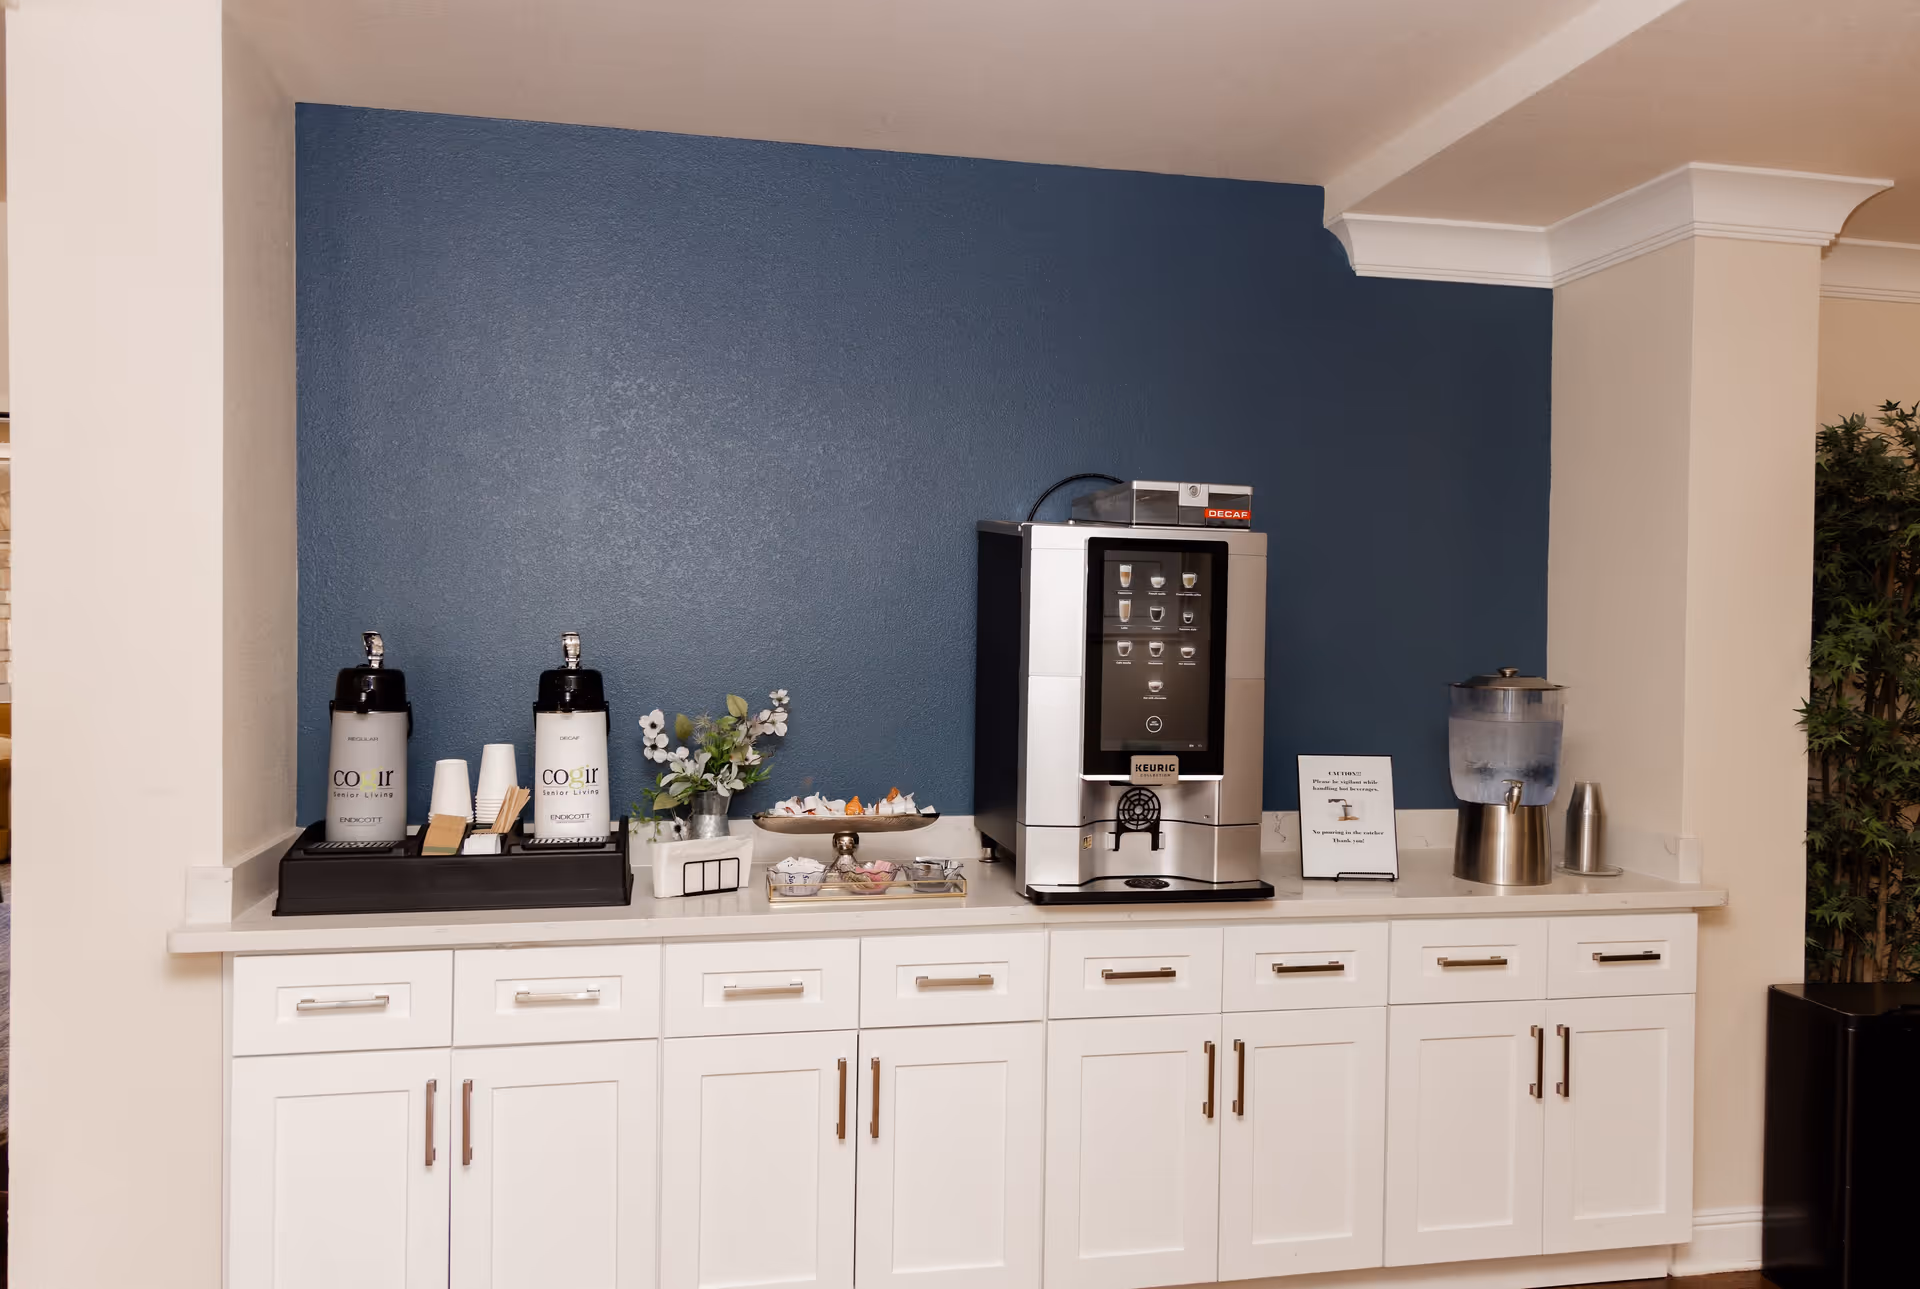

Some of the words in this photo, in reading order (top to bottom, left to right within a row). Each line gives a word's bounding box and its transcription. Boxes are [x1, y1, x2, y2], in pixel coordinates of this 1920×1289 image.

[1208, 509, 1249, 518] DECAF
[1135, 763, 1176, 772] KEURIG
[333, 766, 394, 792] cogir
[542, 764, 599, 789] cogir
[573, 788, 599, 796] Living
[550, 813, 591, 821] ENDICOTT
